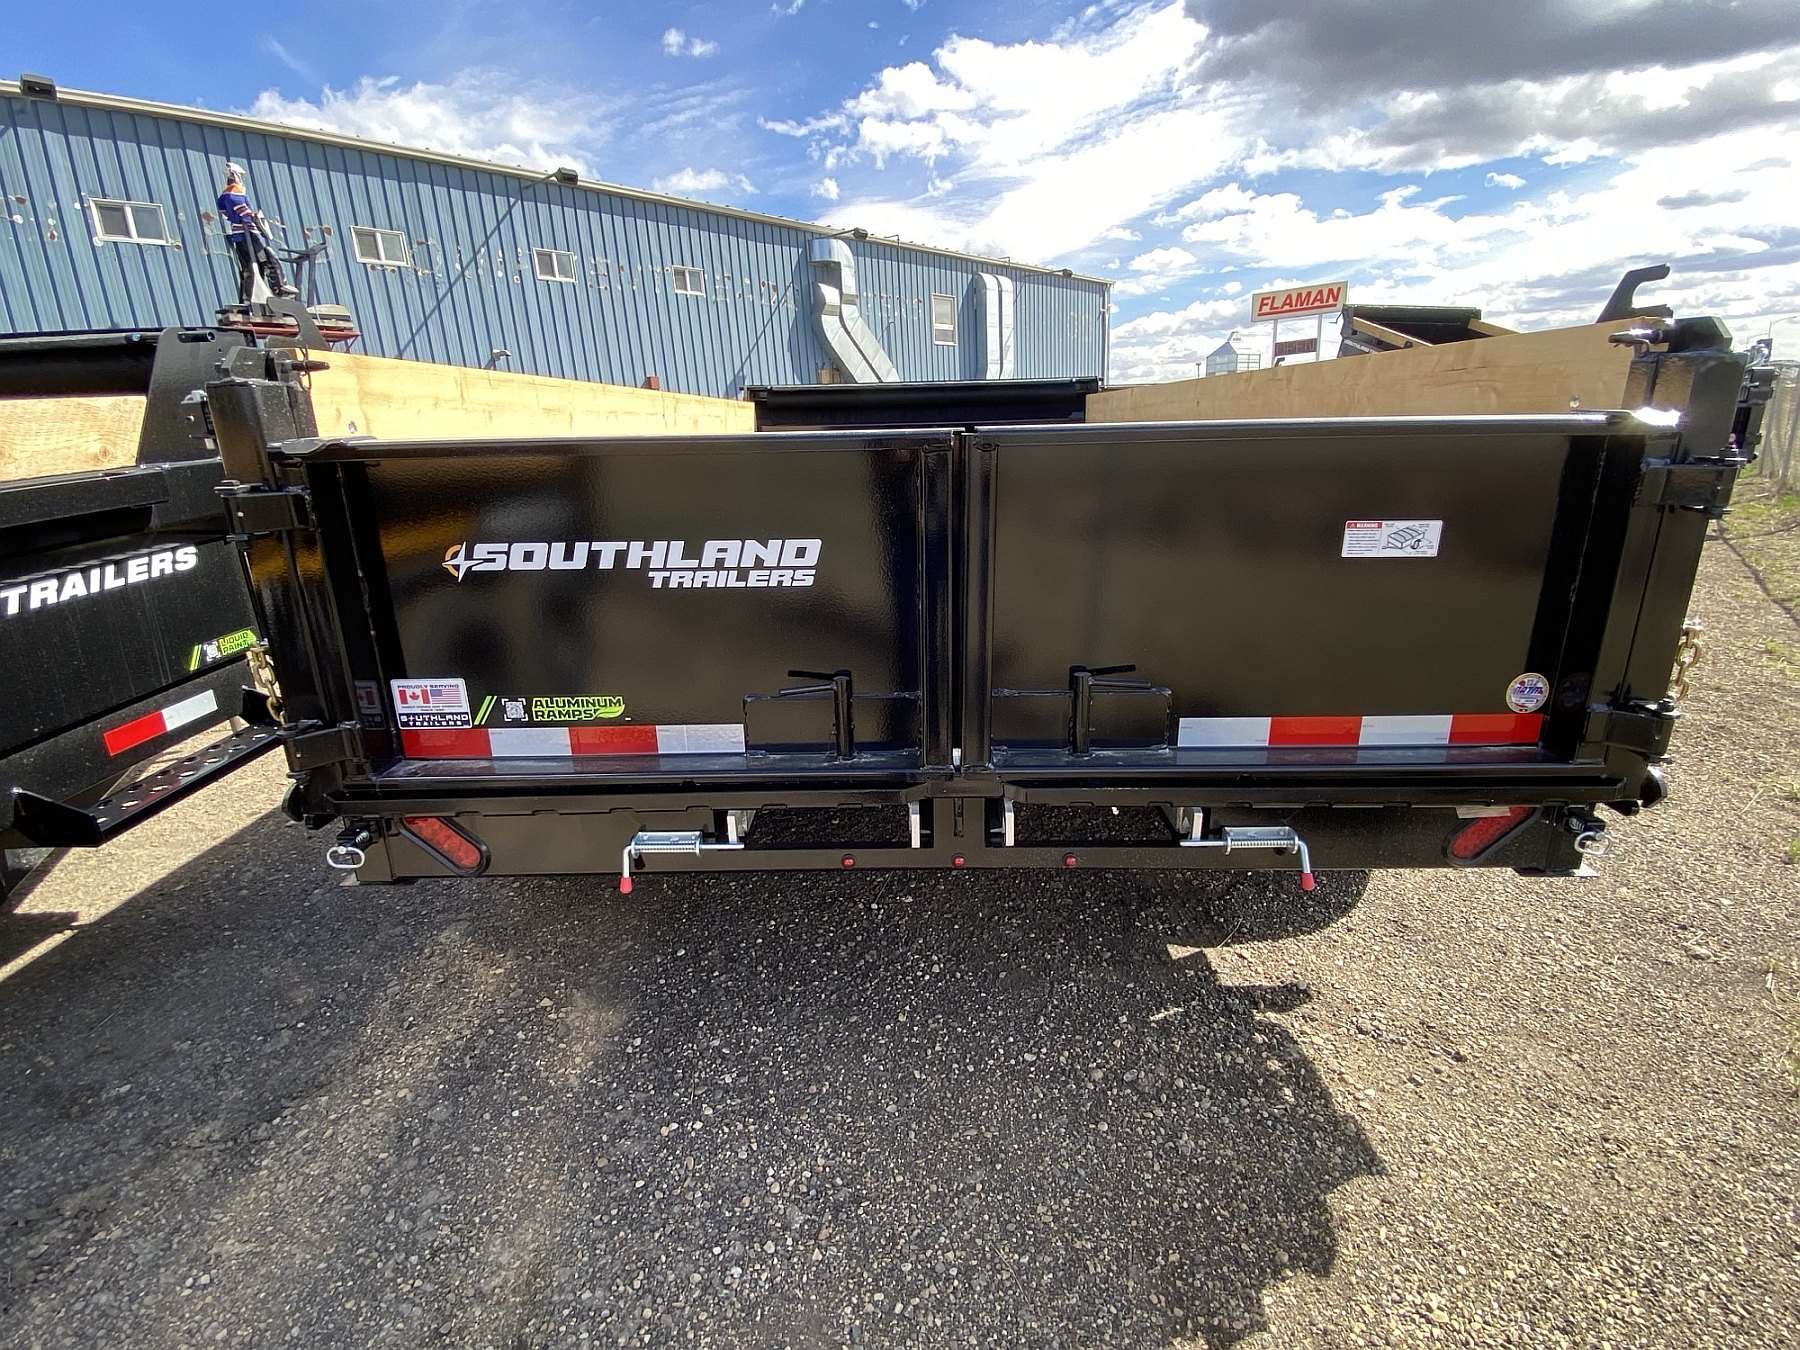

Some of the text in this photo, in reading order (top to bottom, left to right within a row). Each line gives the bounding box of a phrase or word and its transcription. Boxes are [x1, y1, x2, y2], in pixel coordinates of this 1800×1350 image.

[1258, 287, 1342, 312] FLAMAN
[471, 538, 822, 571] SOUTHLAND
[0, 546, 199, 615] TRAILERS
[648, 569, 816, 588] TRAILERS
[220, 631, 249, 646] LIQUID
[534, 697, 623, 709] ALUMINUM
[534, 709, 594, 720] RAMPS
